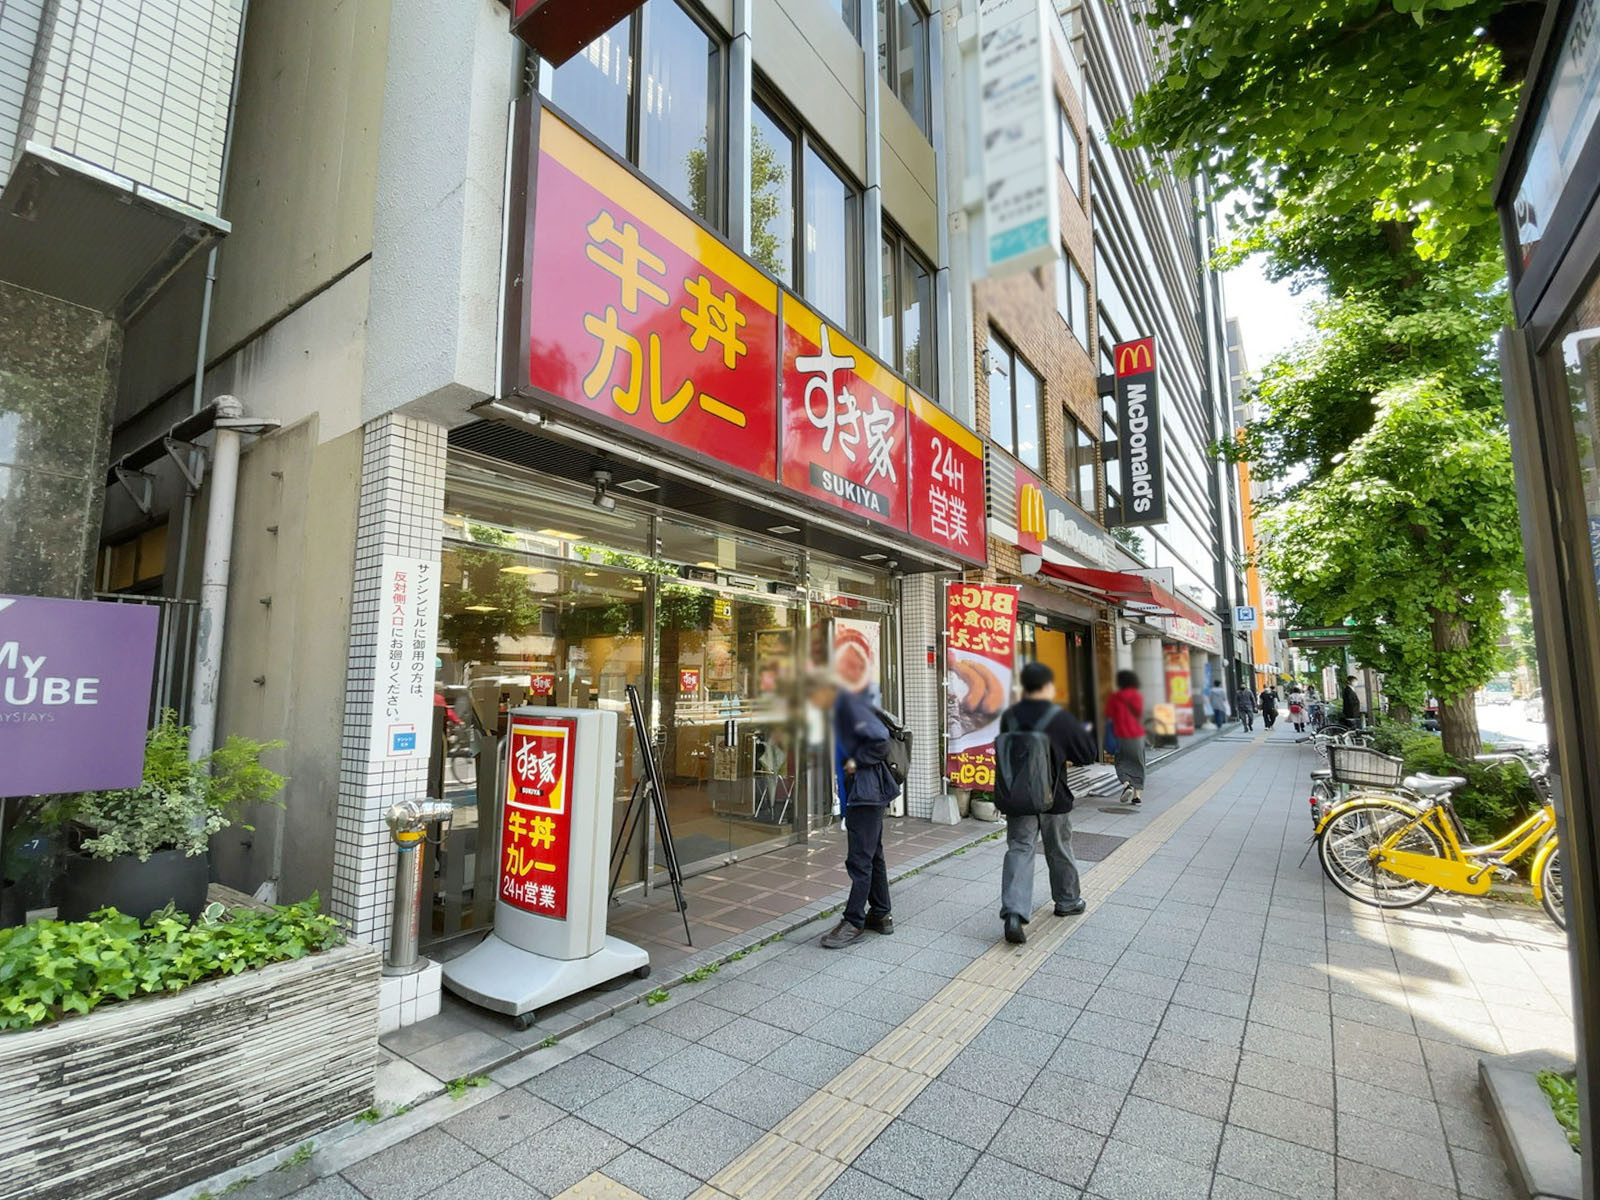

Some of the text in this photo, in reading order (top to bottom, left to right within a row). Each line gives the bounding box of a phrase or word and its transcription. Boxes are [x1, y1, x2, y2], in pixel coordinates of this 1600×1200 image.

[585, 209, 748, 370] 牛丼
[582, 305, 747, 429] カレー
[795, 322, 897, 486] すき家
[930, 436, 965, 494] 24H
[1127, 384, 1154, 513] McDonald's
[822, 470, 881, 513] SUKIYA
[929, 484, 969, 547] 営業
[386, 571, 408, 721] 反対側入口にお廻りください。
[410, 563, 430, 698] サンシンビルに御用の方は、
[515, 736, 557, 788] すき家
[505, 843, 556, 877] カレー
[508, 811, 556, 849] 牛丼
[503, 875, 556, 909] 24H営業
